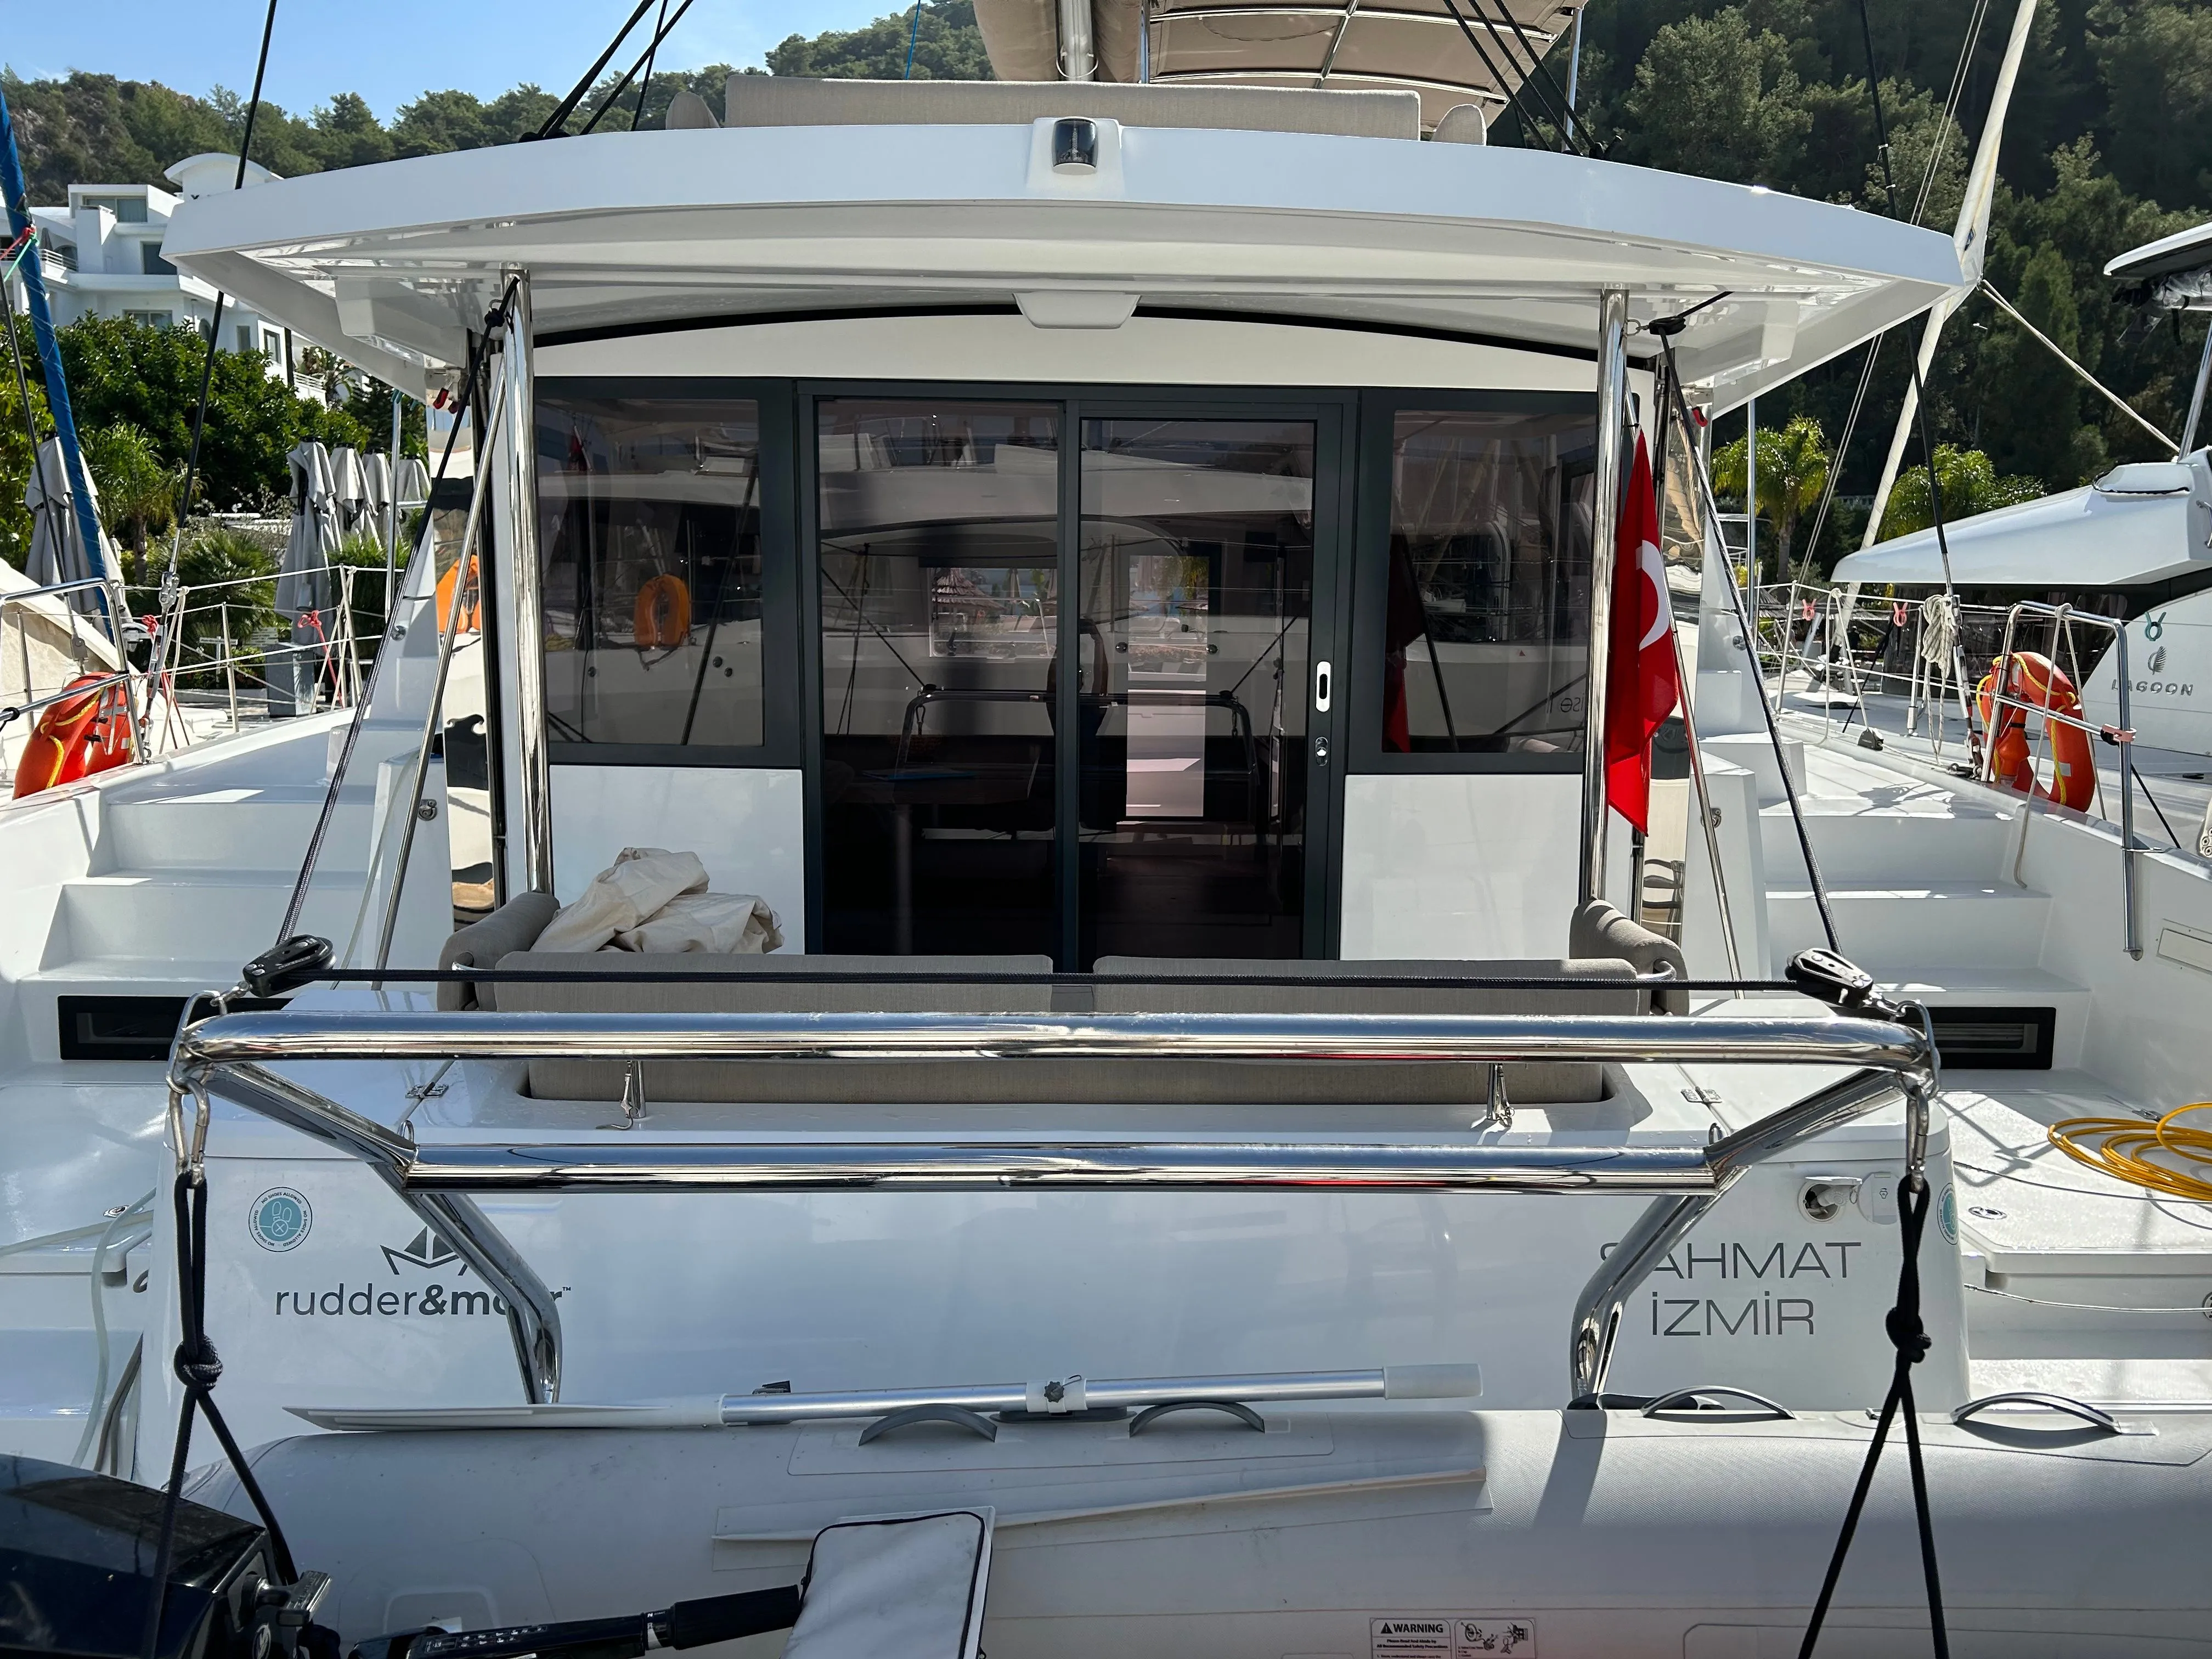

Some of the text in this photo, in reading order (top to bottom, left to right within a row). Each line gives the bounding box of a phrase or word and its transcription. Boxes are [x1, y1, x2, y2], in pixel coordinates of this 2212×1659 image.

[283, 1192, 302, 1204] ALLOWED
[256, 1231, 268, 1243] SHOES
[283, 1233, 301, 1246] ALLOWED
[1652, 1291, 1815, 1335] İZMİR
[1393, 1623, 1443, 1633] WARNING
